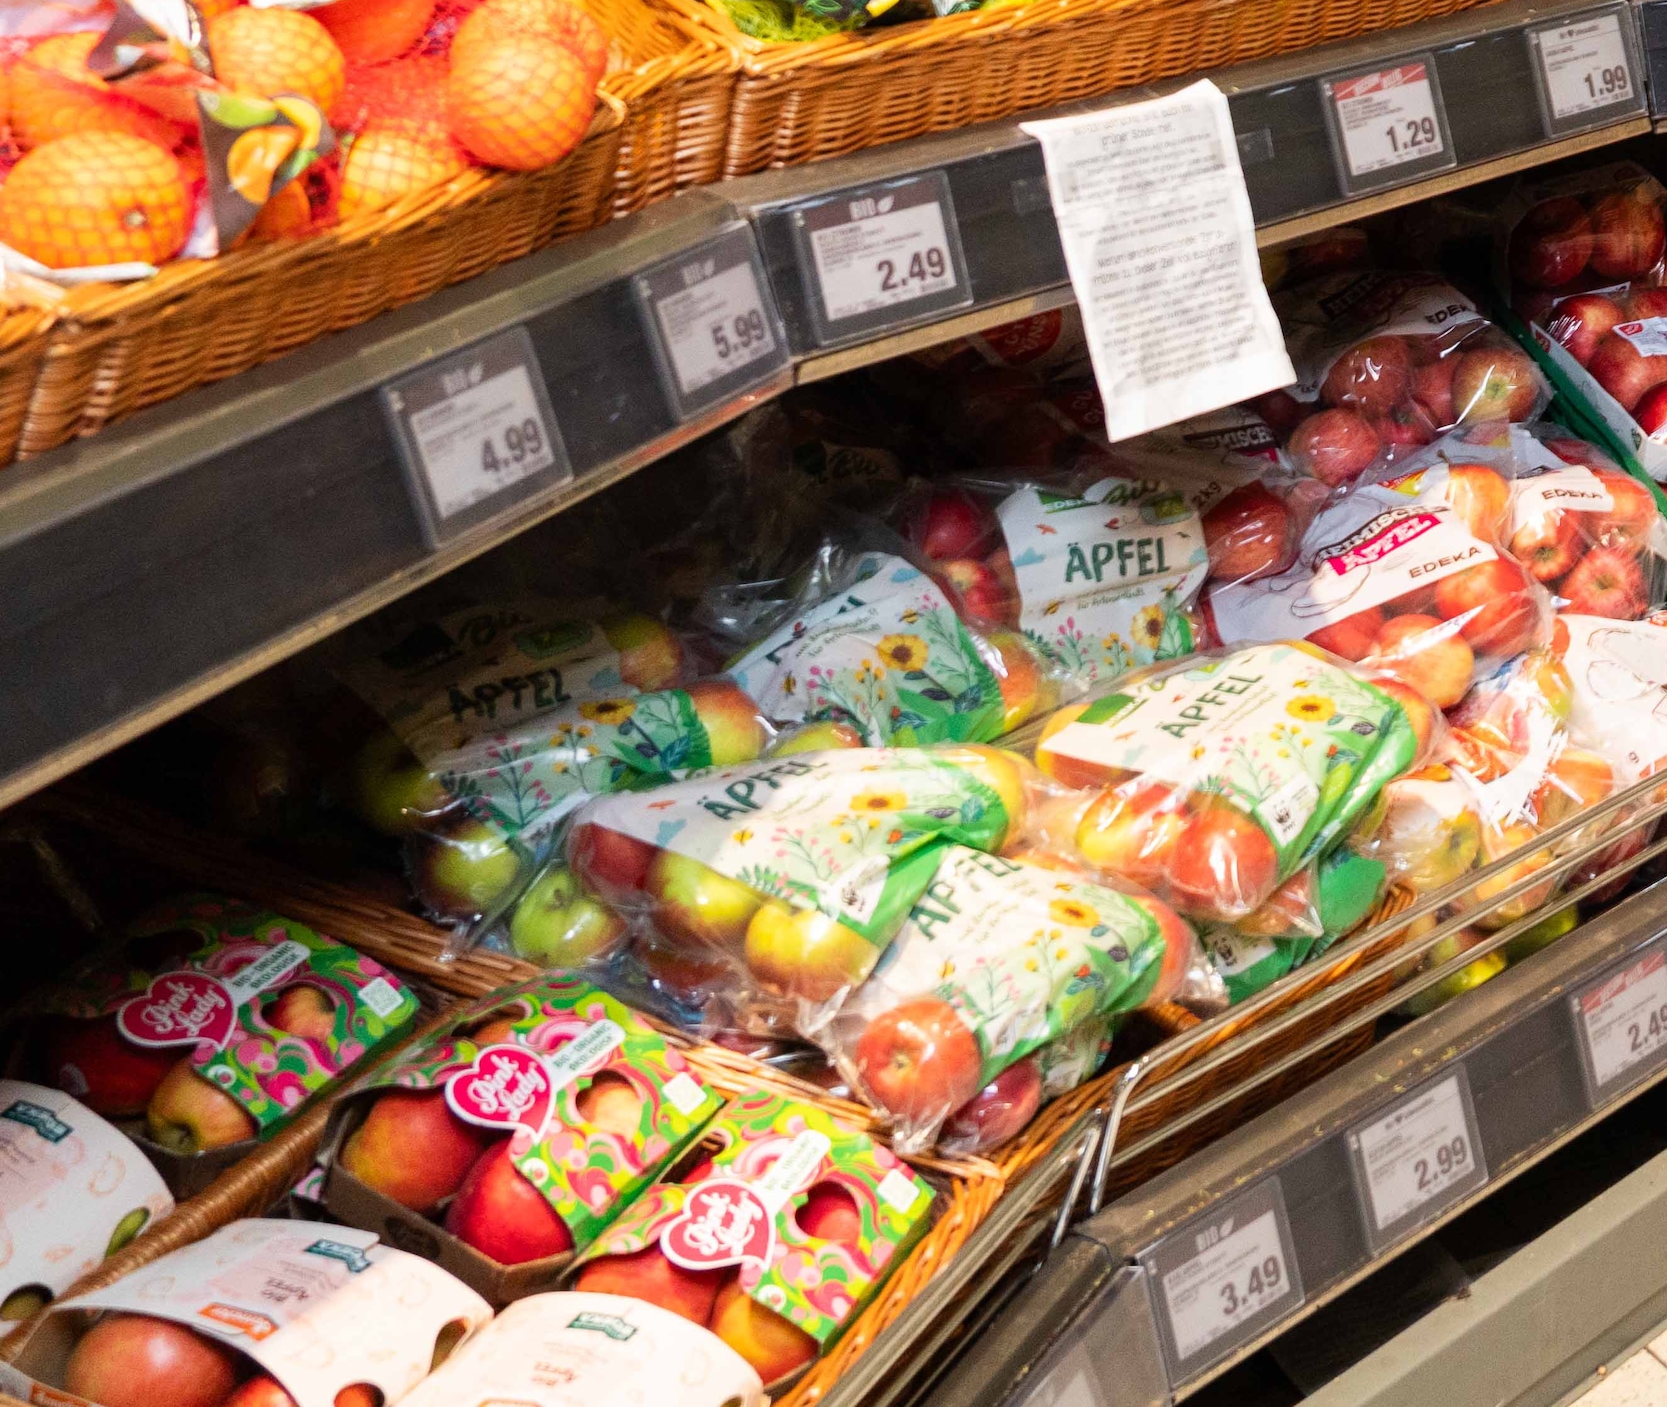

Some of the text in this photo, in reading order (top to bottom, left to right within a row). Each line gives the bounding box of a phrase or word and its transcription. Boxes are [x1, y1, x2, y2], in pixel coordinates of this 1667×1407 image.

[1584, 65, 1627, 98] 1.99
[1386, 117, 1436, 153] 1.29
[879, 248, 948, 292] 2.49
[713, 308, 766, 359] 5.99
[481, 418, 546, 474] 4.99
[1542, 488, 1604, 500] EDEKA
[1065, 536, 1171, 583] ÄPFEL
[1341, 514, 1434, 568] ÄPFEL
[1408, 545, 1481, 579] EDEKA
[1154, 674, 1264, 740] ÄPFEL
[697, 759, 830, 822] ÄPFEL
[910, 849, 1024, 941] ÄPFEL
[142, 981, 199, 1033] Pink
[182, 987, 227, 1038] Lady
[467, 1054, 521, 1114] Pink
[496, 1061, 547, 1121] Lady
[1414, 1136, 1467, 1193] 2.99
[683, 1191, 732, 1257] Pink
[719, 1187, 764, 1257] Lady
[1219, 1261, 1281, 1316] 3.49
